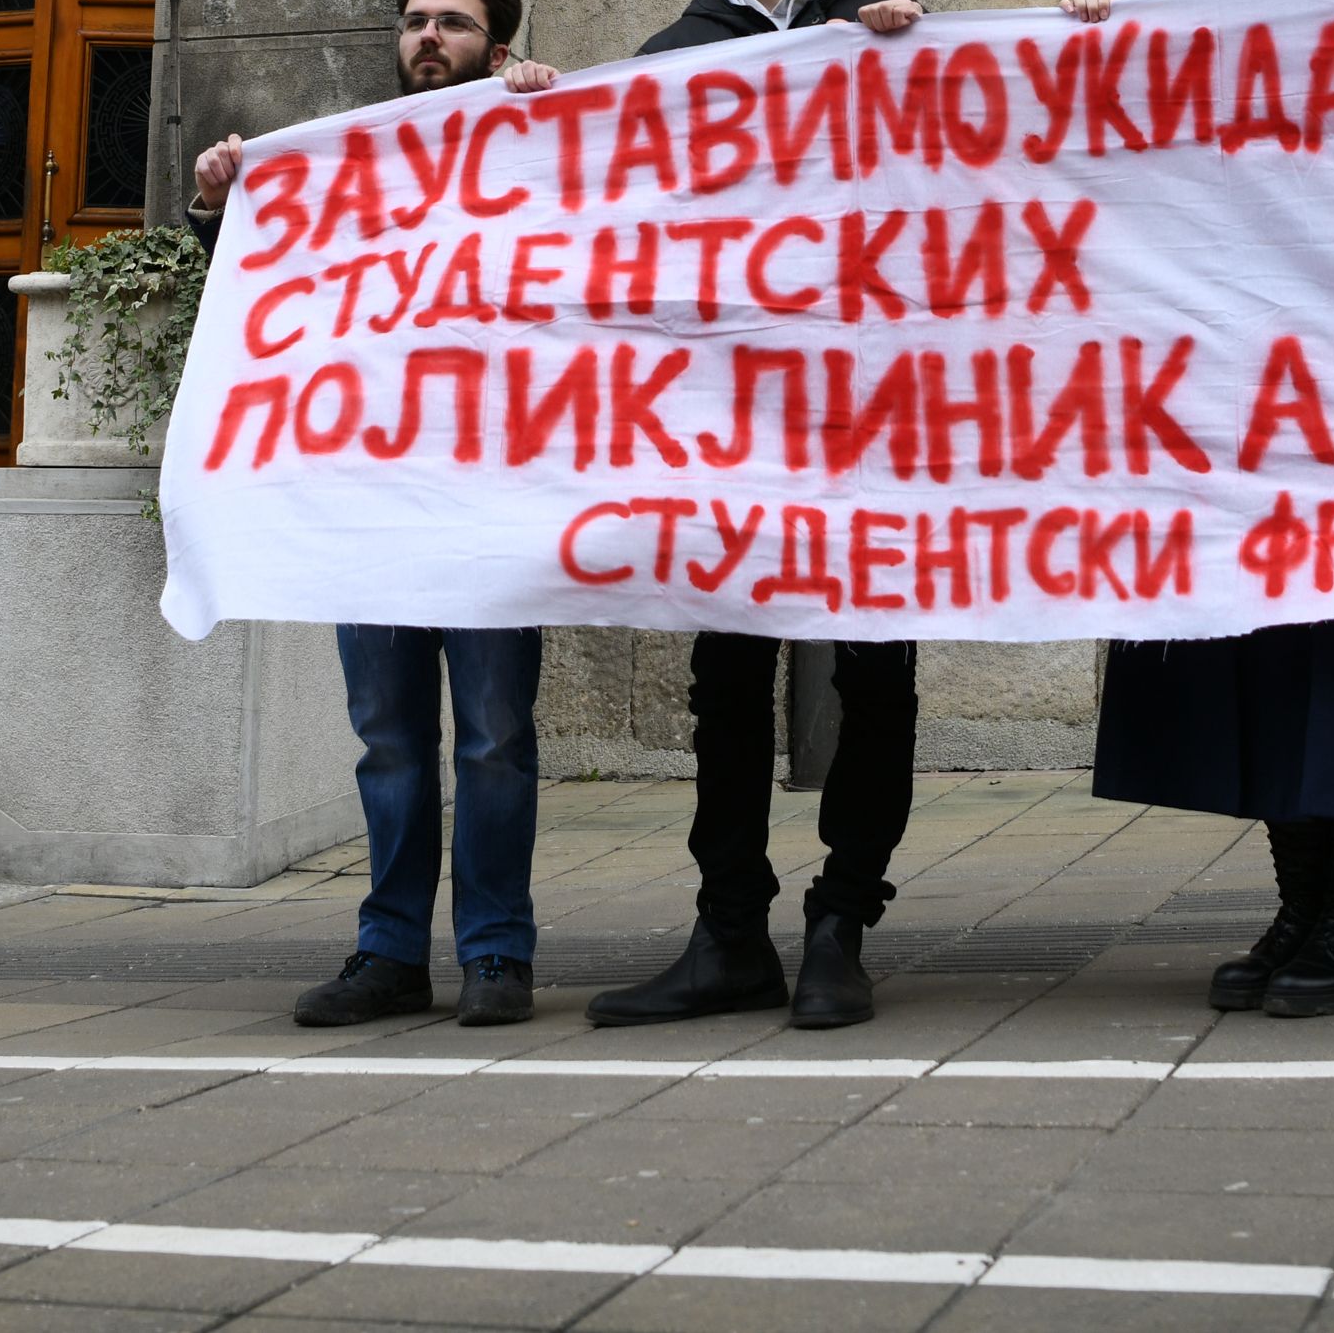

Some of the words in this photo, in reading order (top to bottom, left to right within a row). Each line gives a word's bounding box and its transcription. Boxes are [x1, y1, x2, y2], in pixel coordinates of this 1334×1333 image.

[238, 42, 1010, 272] ЗАУСТАВИМО
[243, 198, 1098, 361] СТУДЕНТСКИХ
[559, 496, 1193, 614] СТУДЕНТСКИ
